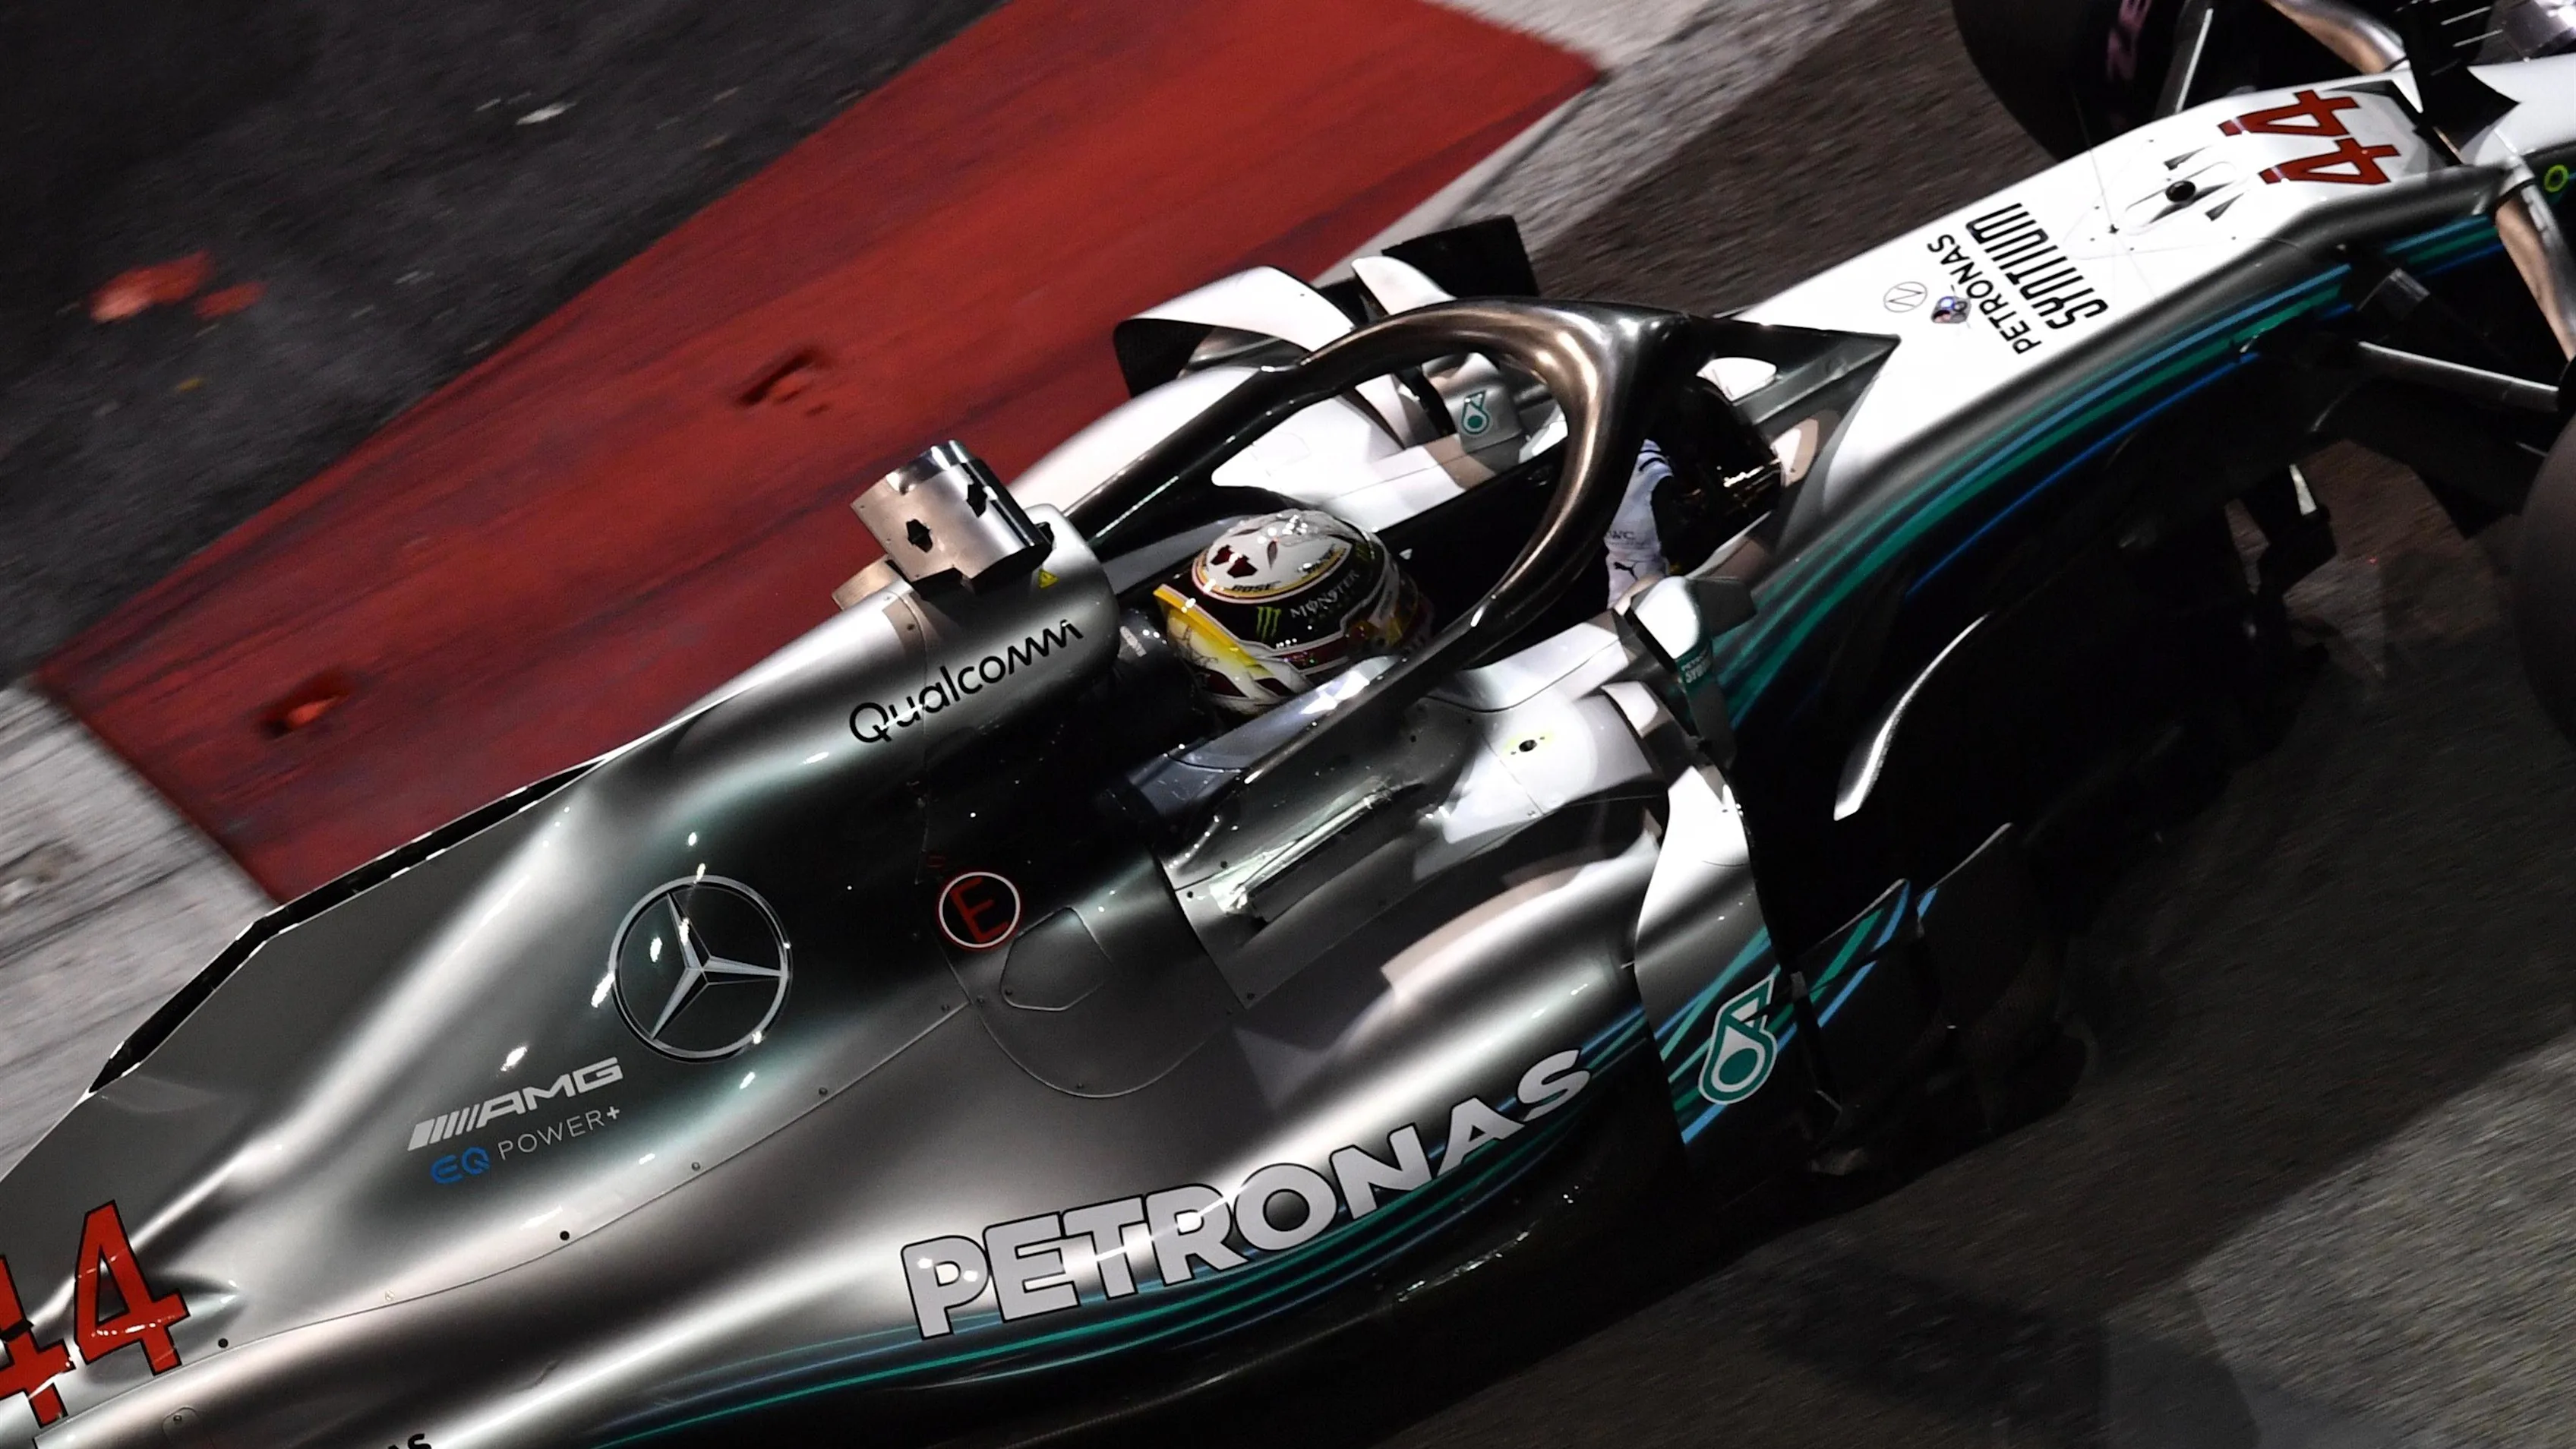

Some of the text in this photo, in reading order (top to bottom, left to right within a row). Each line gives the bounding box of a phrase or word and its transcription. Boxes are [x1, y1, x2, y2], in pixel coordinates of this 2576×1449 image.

[2218, 89, 2401, 185] 44
[1927, 234, 2042, 355] PETRONAS
[1965, 203, 2109, 329] SYNTIUM
[1290, 570, 1359, 617] MONSTER
[849, 619, 1084, 743] Qualcomm
[949, 876, 1009, 944] E
[476, 1056, 623, 1129] AMG
[431, 1106, 620, 1184] EQ POWER+
[901, 1049, 1591, 1340] PETRONAS
